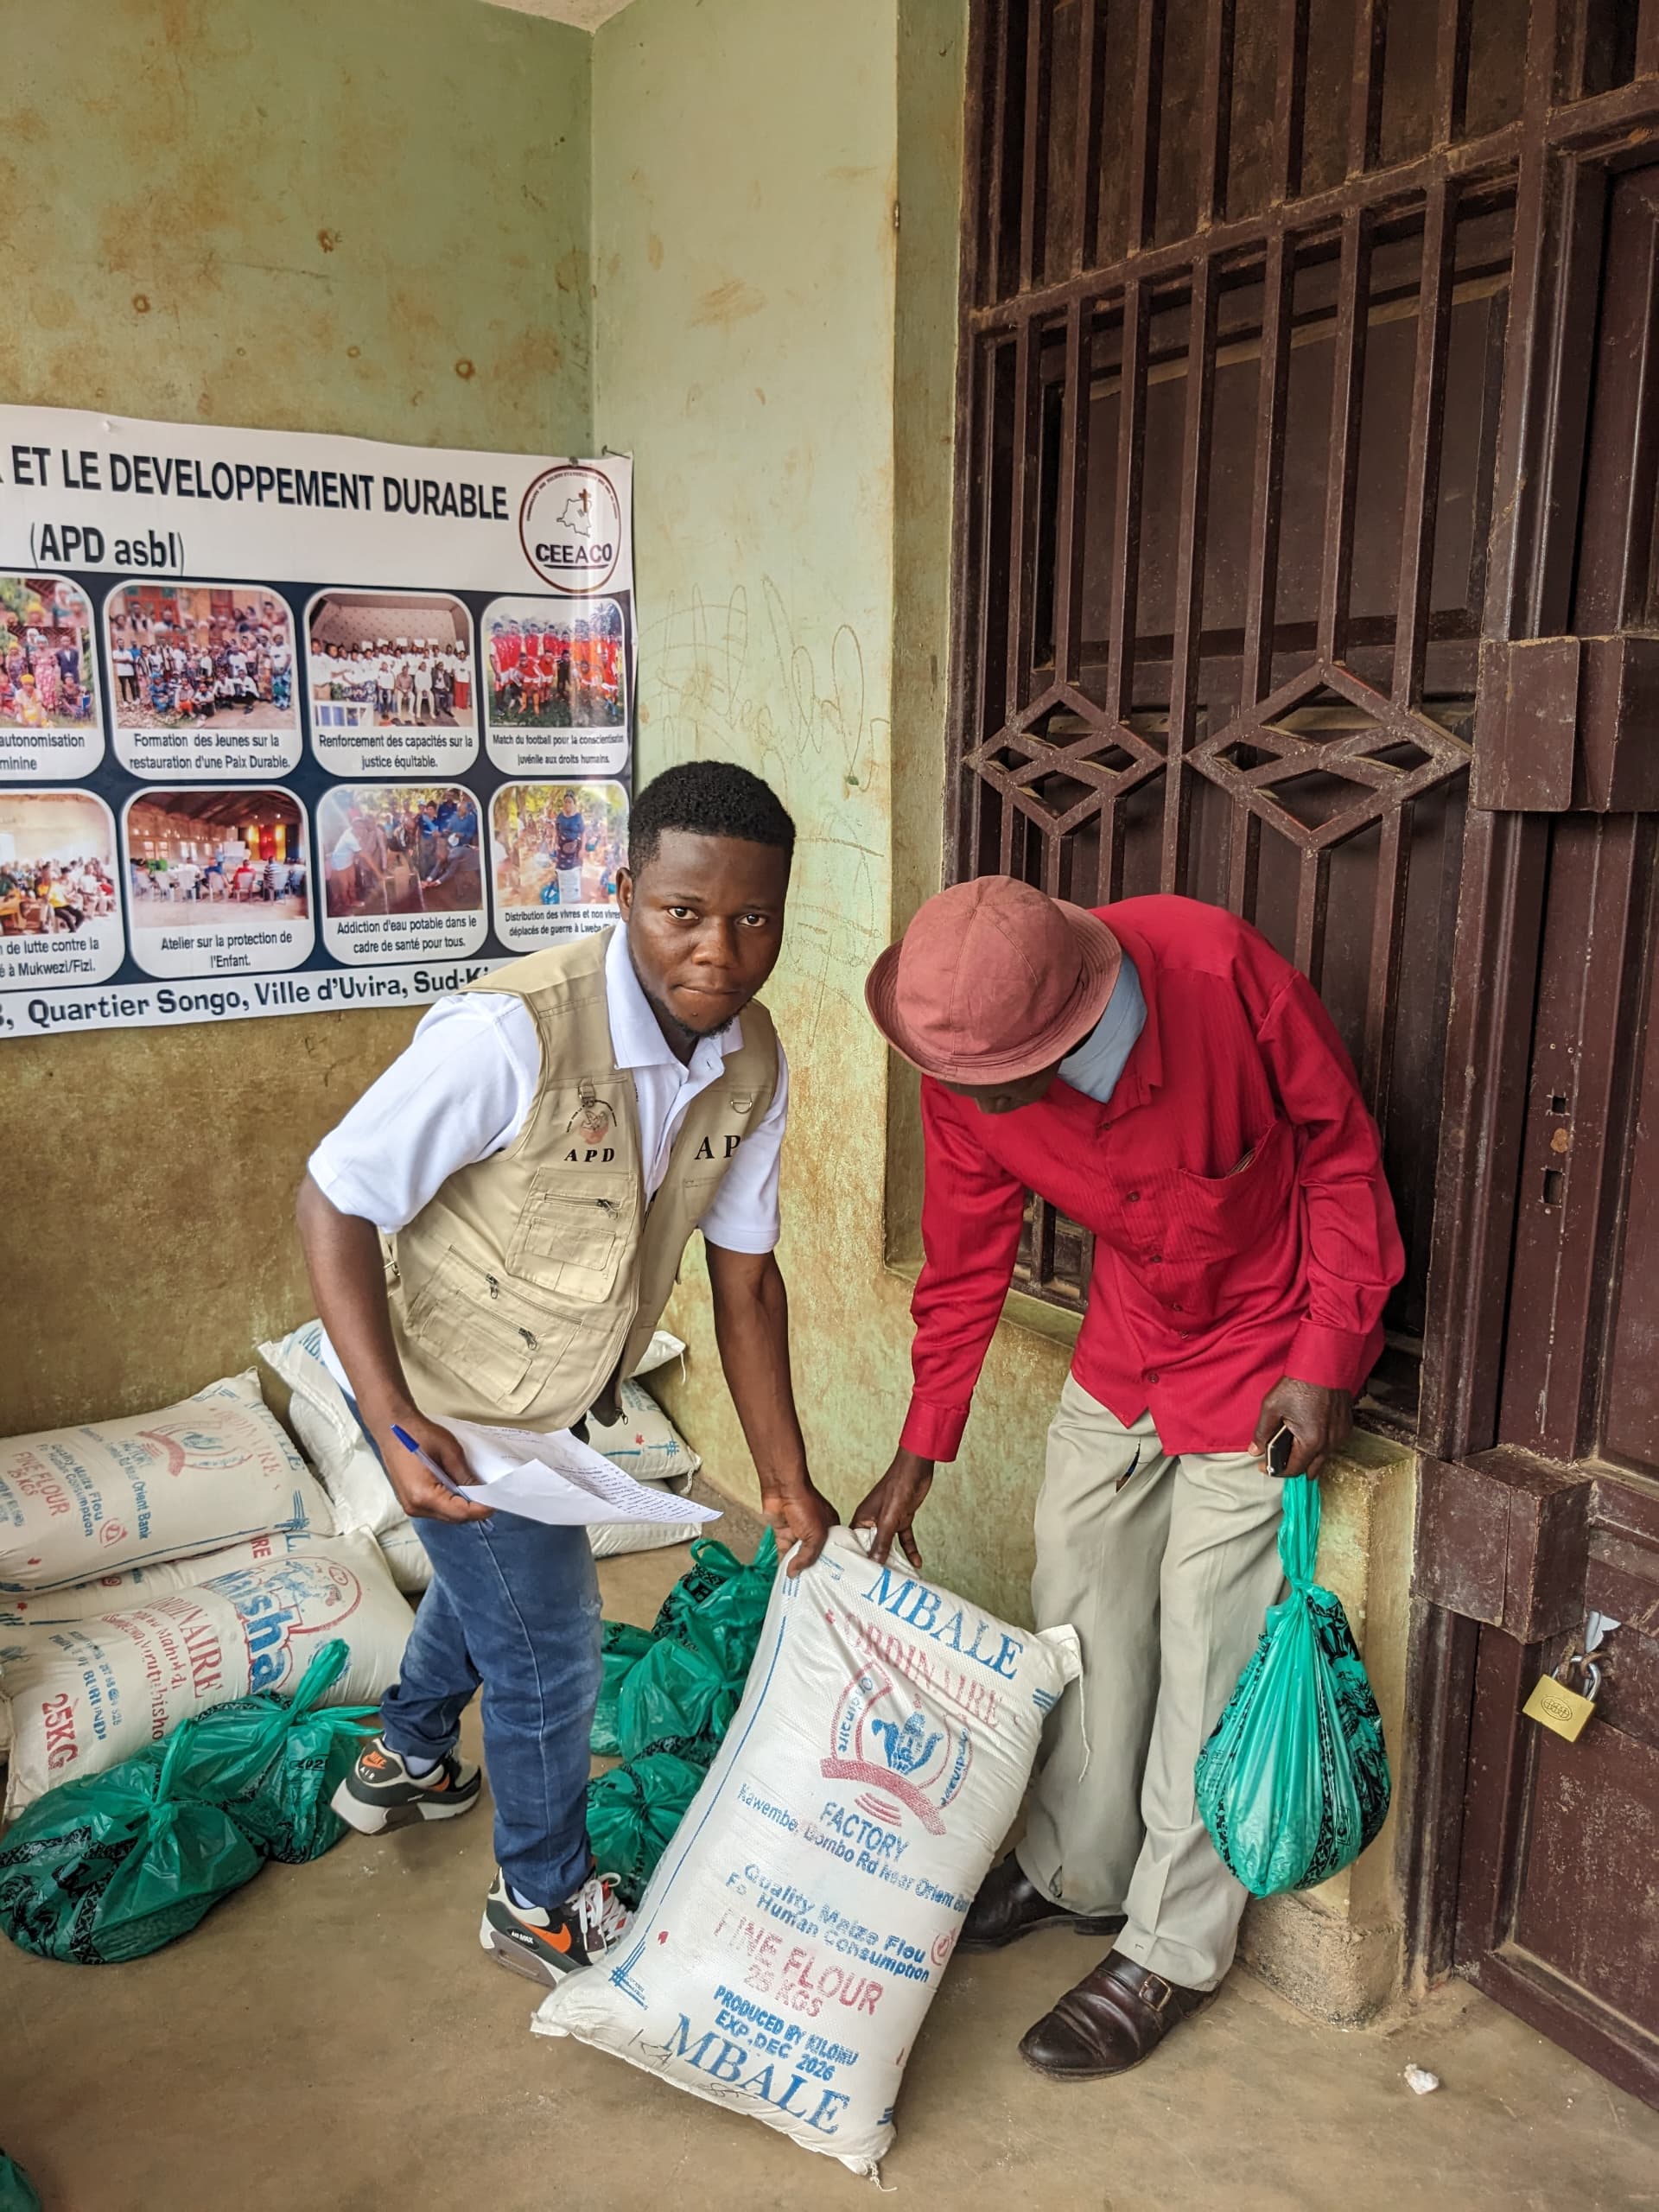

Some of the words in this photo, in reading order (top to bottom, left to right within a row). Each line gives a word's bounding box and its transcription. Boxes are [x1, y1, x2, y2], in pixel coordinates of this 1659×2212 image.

[12, 445, 51, 486] ET
[61, 449, 101, 491] LE
[109, 453, 374, 511] DEVELOPPEMENT
[383, 476, 509, 520] DURABLE
[30, 522, 105, 569] (APD
[114, 530, 184, 576] asbl)
[536, 543, 613, 564] CEEACO
[134, 734, 188, 747] Formation
[194, 734, 213, 747] des
[215, 734, 250, 747] Jeunes
[252, 736, 267, 747] sur
[270, 734, 279, 747] la
[319, 734, 385, 747] Renforcement
[387, 734, 403, 747] des
[405, 734, 448, 750] capacités
[449, 737, 462, 747] sur
[465, 735, 473, 747] la
[493, 734, 513, 745] Match
[516, 734, 524, 745] du
[526, 734, 551, 745] football
[553, 736, 569, 747] pour
[571, 734, 577, 744] la
[130, 755, 192, 769] restauration
[195, 755, 223, 768] d'une
[226, 755, 247, 768] Paix
[250, 755, 290, 768] Durable.
[361, 754, 391, 771] justice
[394, 754, 438, 771] équitable.
[518, 753, 543, 766] juvénile
[558, 754, 579, 764] droits
[337, 921, 380, 935] Addiction
[383, 919, 407, 932] d'eau
[410, 917, 443, 933] potable
[446, 916, 466, 928] dans
[468, 915, 477, 927] le
[505, 911, 544, 922] Distribution
[546, 910, 558, 920] des
[561, 909, 581, 918] vivres
[582, 909, 590, 918] et
[161, 937, 194, 950] Atelier
[197, 936, 213, 948] sur
[216, 934, 224, 947] la
[227, 932, 277, 948] protection
[280, 931, 292, 943] de
[510, 926, 539, 938] déplacés
[541, 925, 550, 934] de
[550, 925, 572, 936] guerre
[7, 941, 21, 955] de
[24, 939, 48, 952] lutte
[52, 938, 86, 951] contre
[90, 937, 99, 950] la
[353, 940, 378, 954] cadre
[381, 940, 393, 951] de
[395, 938, 420, 950] santé
[423, 938, 442, 951] pour
[444, 936, 466, 948] tous.
[9, 964, 15, 976] à
[211, 954, 251, 969] l'Enfant.
[28, 994, 149, 1028] Quartier
[156, 989, 250, 1015] Songo,
[255, 981, 311, 1006] Ville
[317, 975, 409, 1001] d'Uvira,
[414, 967, 489, 994] Sud-K
[563, 1147, 615, 1163] APD
[694, 1135, 741, 1160] AP
[31, 1472, 70, 1516] FLOUR
[137, 1511, 152, 1540] Bank
[861, 1567, 1024, 1680] MBALE
[145, 1597, 223, 1699] ORDINAIRE
[41, 1693, 79, 1770] 25KG
[359, 1767, 375, 1780] AIR
[821, 1802, 910, 1861] FACTORY
[856, 1850, 879, 1875] Rd
[744, 1863, 816, 1916] Quality
[817, 1903, 879, 1948] Maize
[883, 1935, 929, 1964] Flou
[756, 1893, 819, 1938] Human
[823, 1929, 931, 1984] Consumption
[782, 1946, 884, 2016] FLOUR
[714, 1985, 785, 2035] PRODUCED
[784, 2024, 808, 2045] BY
[662, 2012, 851, 2135] MBALE
[795, 2054, 836, 2082] 2026
